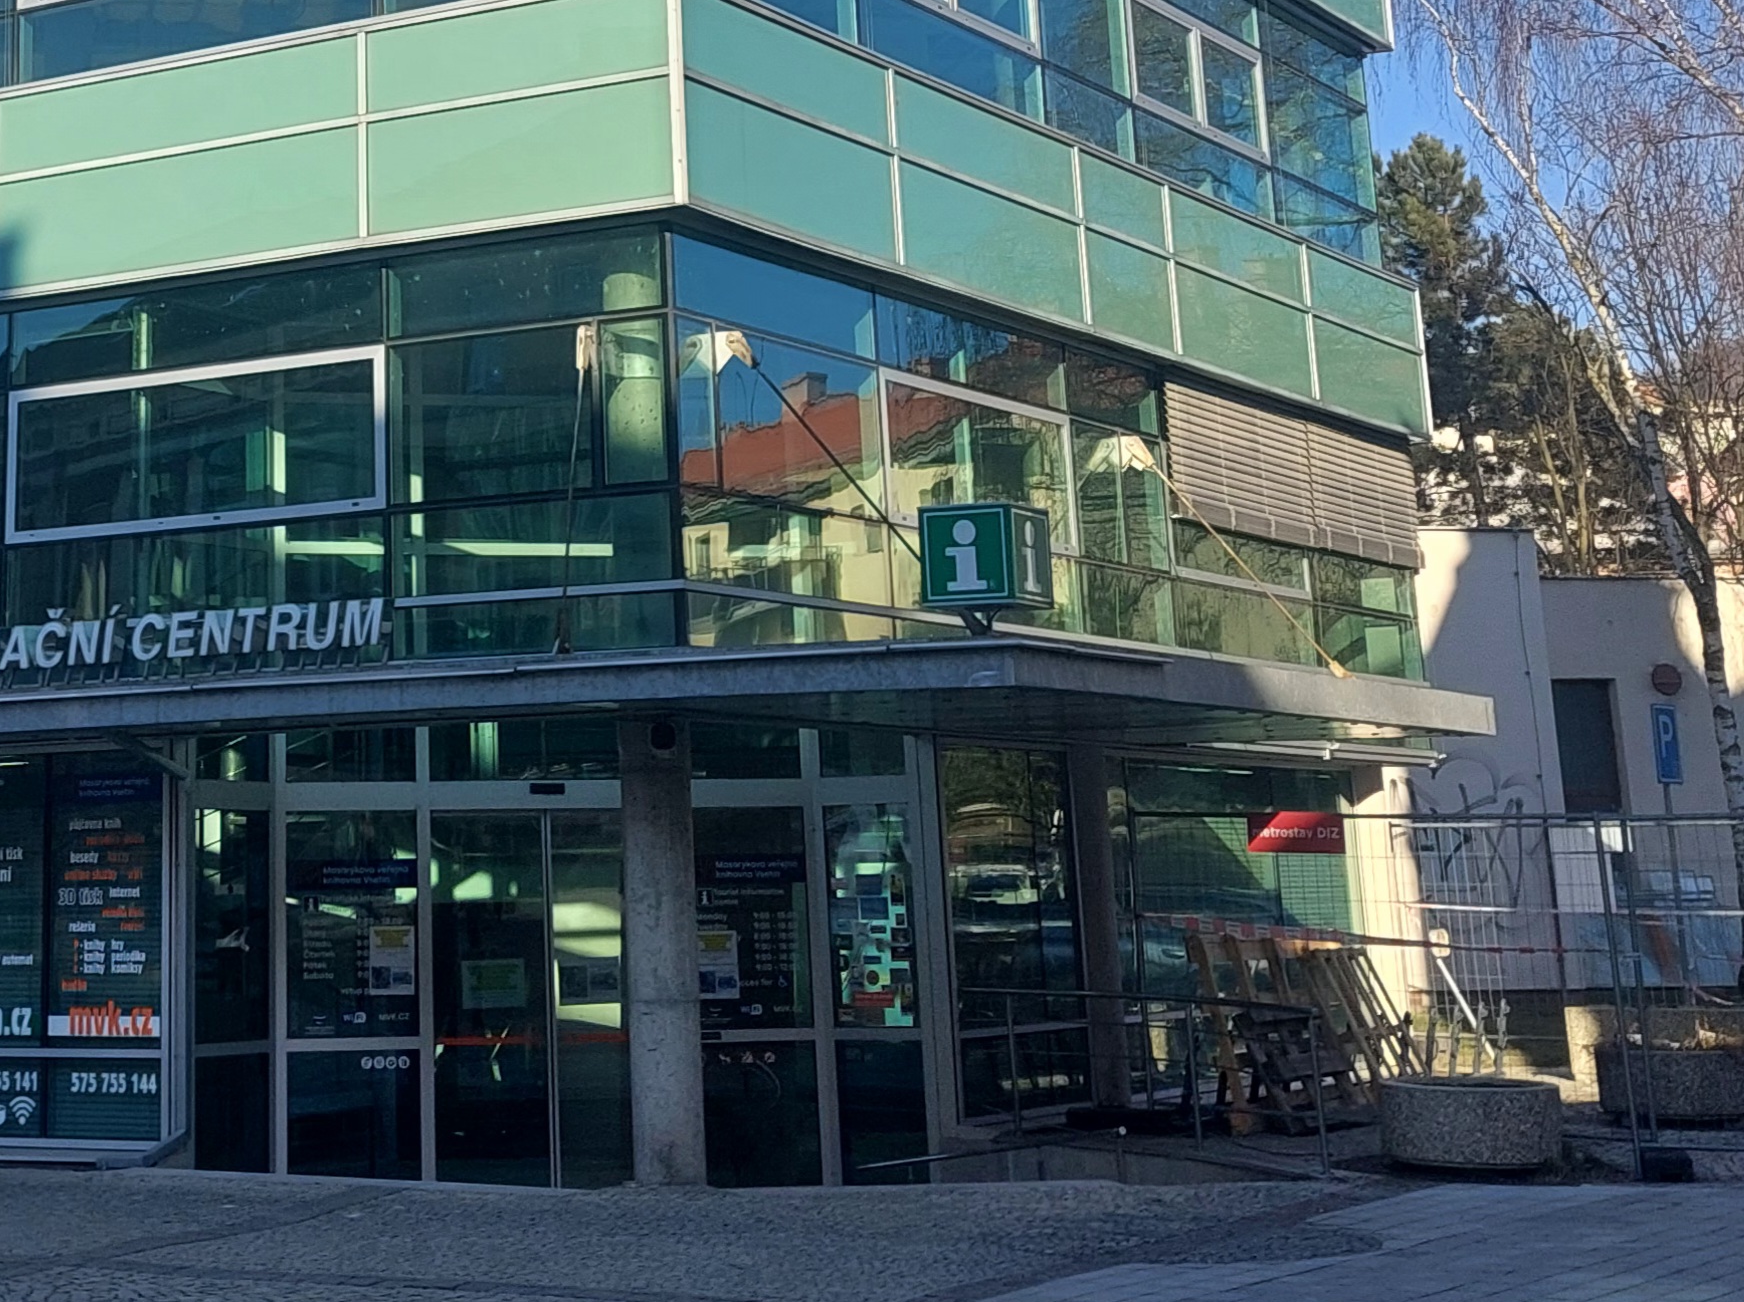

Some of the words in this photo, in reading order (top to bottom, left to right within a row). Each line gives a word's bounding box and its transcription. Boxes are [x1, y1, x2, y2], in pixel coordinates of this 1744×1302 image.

[945, 519, 988, 591] i
[1021, 520, 1042, 593] i
[129, 597, 385, 662] CENTRUM
[1658, 714, 1674, 758] P
[5, 847, 24, 860] tisk
[70, 851, 99, 864] besedy
[58, 888, 76, 905] 3D
[78, 887, 104, 905] tisk
[111, 950, 146, 964] periodika
[111, 962, 144, 975] komiksy
[69, 999, 154, 1036] mvk.cz
[14, 1070, 38, 1092] 141
[70, 1072, 97, 1094] 575
[101, 1072, 127, 1094] 755
[131, 1072, 157, 1095] 144
